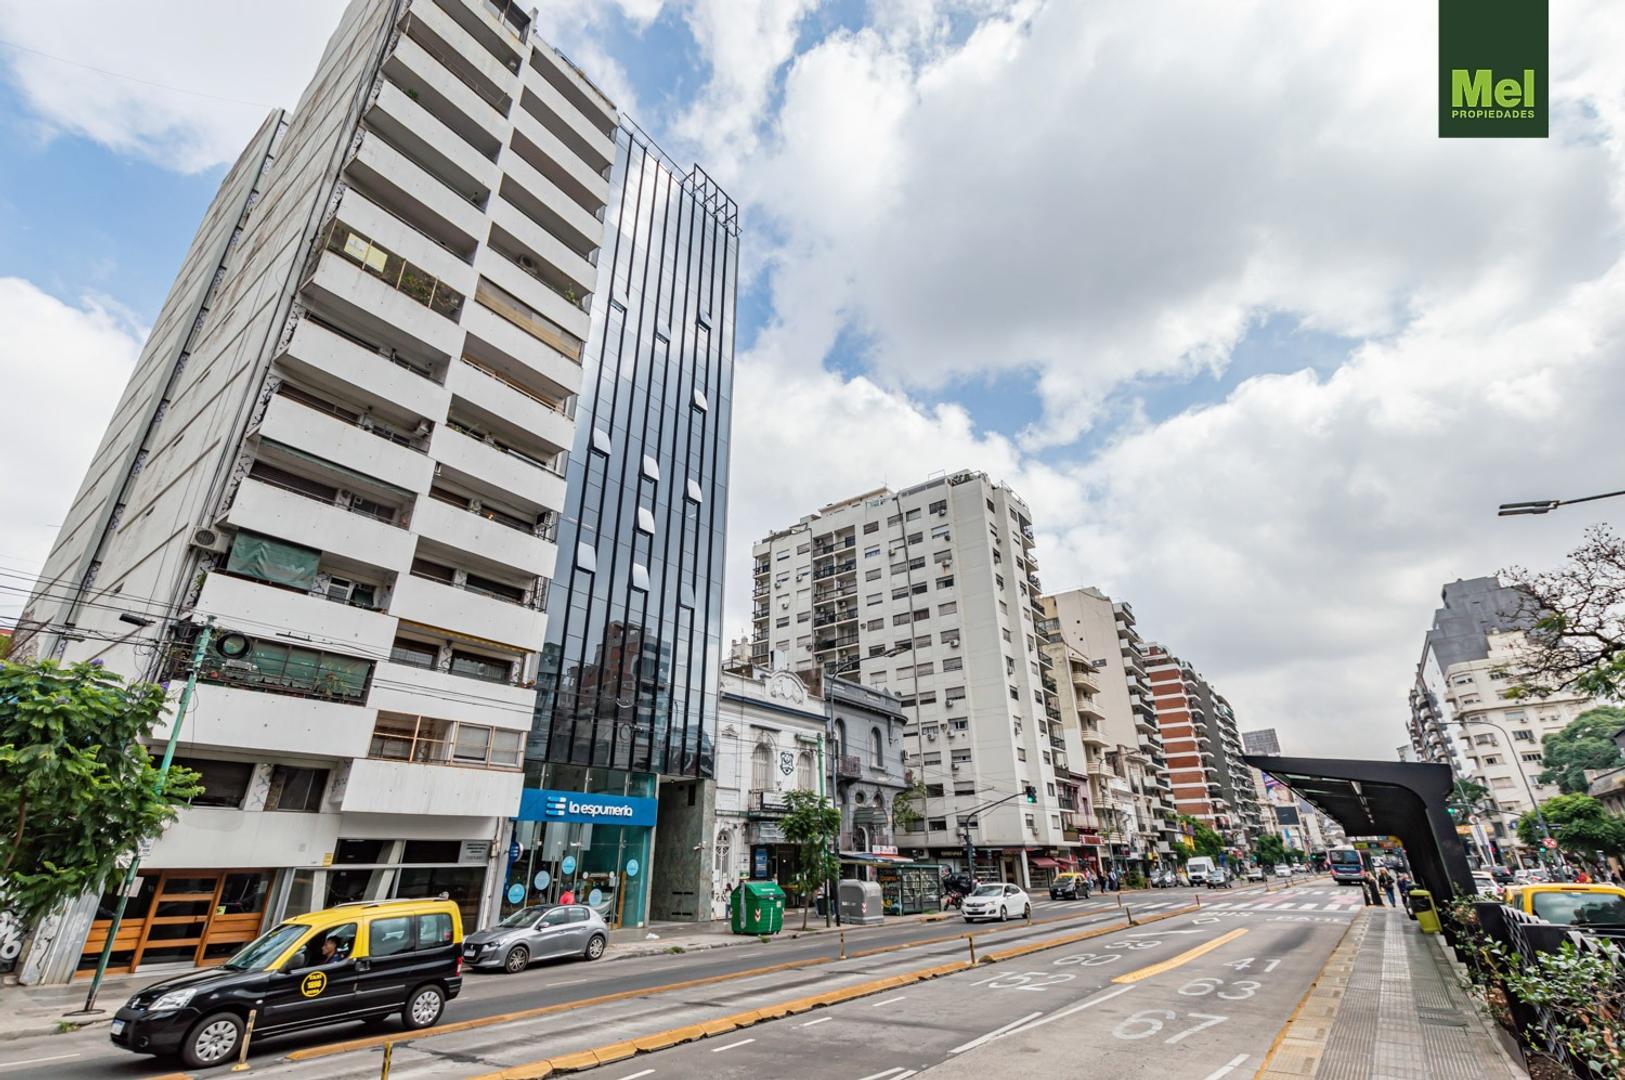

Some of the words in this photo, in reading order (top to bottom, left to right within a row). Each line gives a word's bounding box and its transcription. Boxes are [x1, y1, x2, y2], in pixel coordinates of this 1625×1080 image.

[569, 801, 579, 814] la
[1054, 953, 1122, 967] 60
[1223, 957, 1282, 973] 41
[969, 971, 1077, 992] 152
[1177, 978, 1262, 1000] 63
[1111, 1009, 1229, 1044] 67
